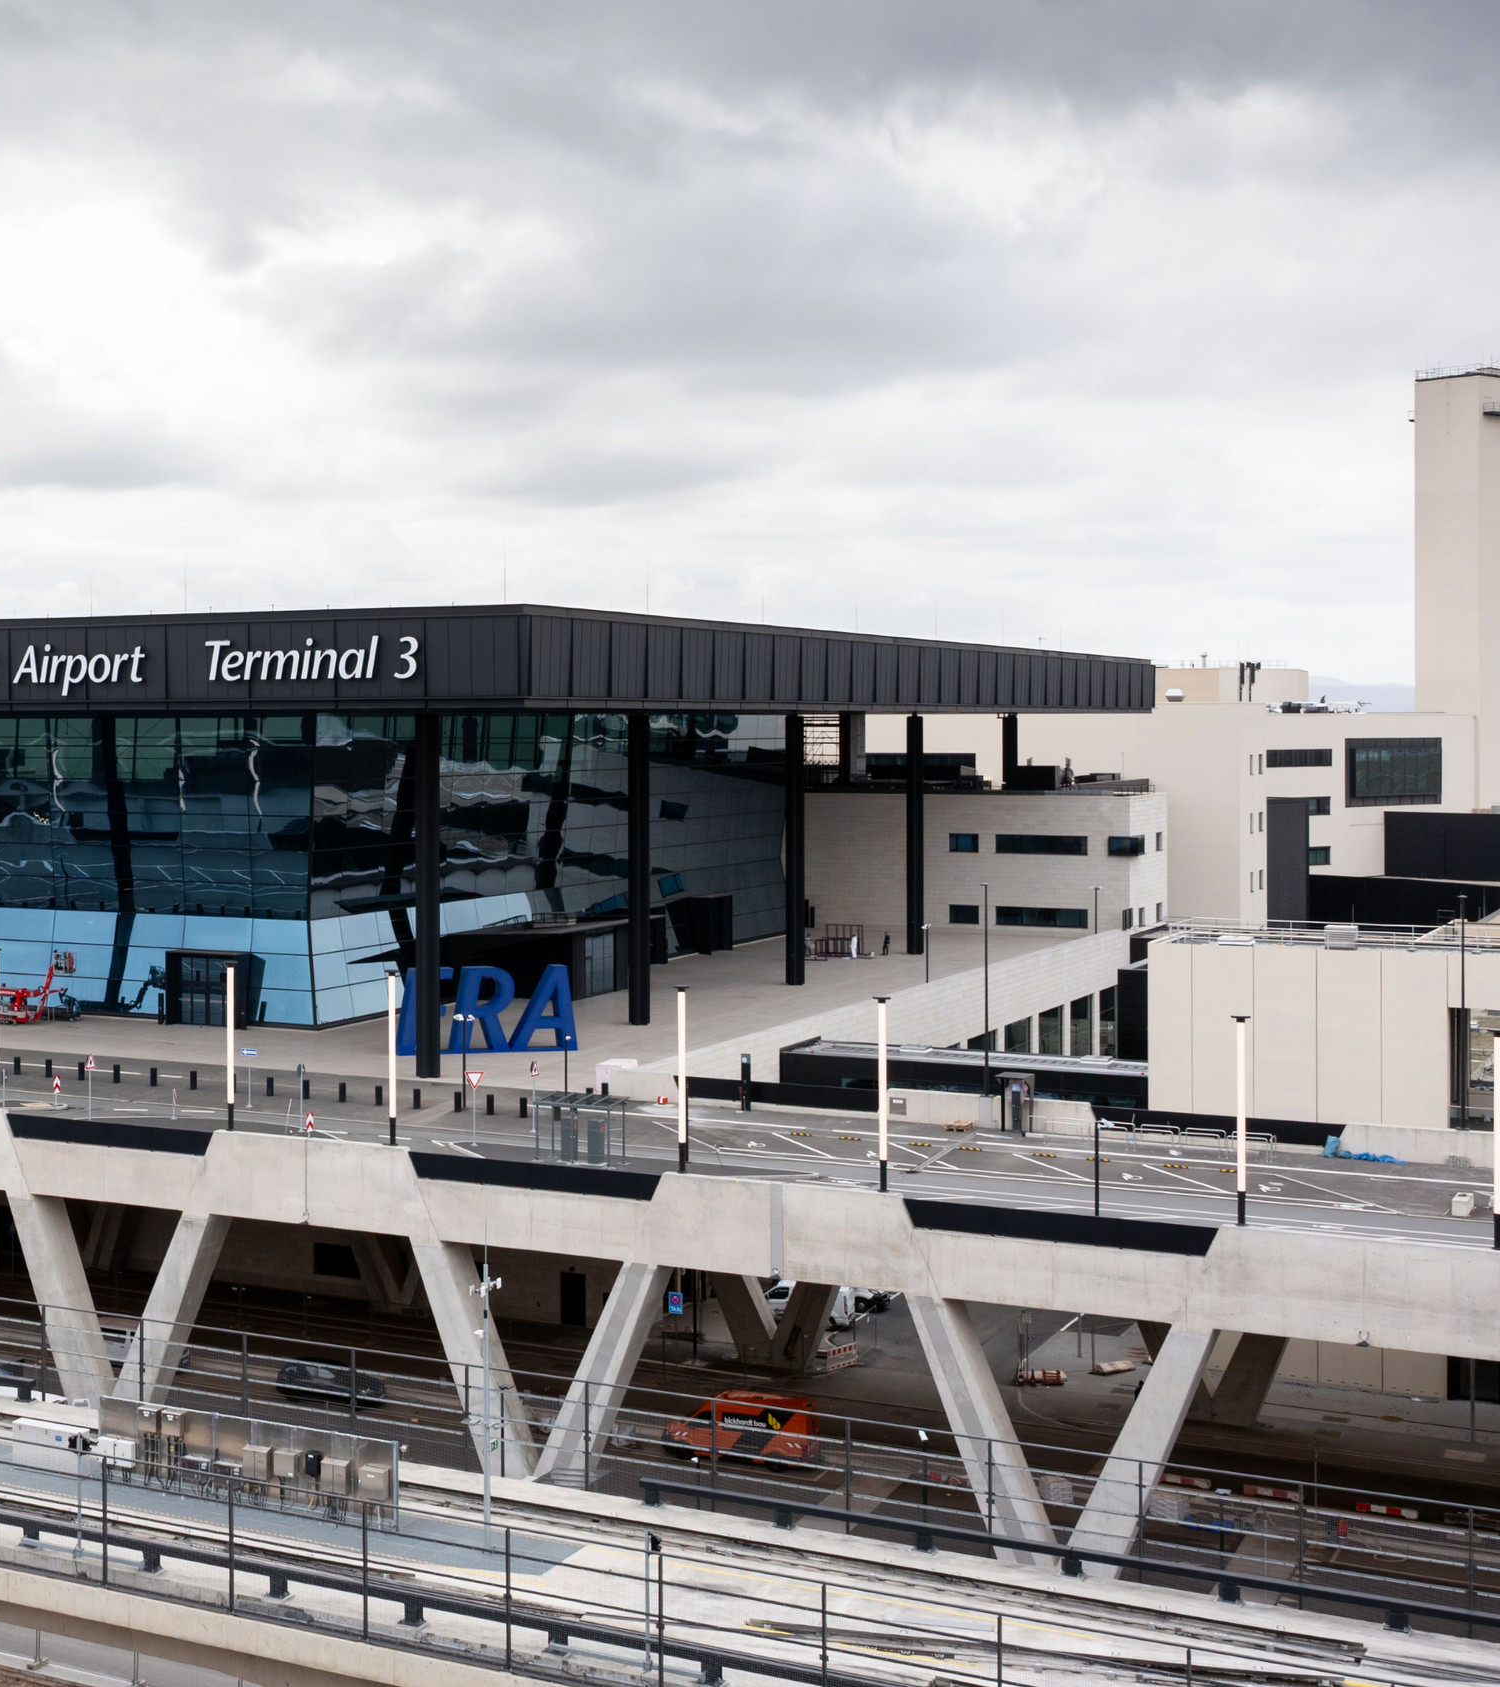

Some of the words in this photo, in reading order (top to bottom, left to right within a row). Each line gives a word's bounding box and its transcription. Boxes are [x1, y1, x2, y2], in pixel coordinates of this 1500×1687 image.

[12, 643, 146, 696] Airport
[204, 635, 379, 682] Terminal
[393, 636, 419, 679] 3
[396, 964, 578, 1056] FRA
[754, 1419, 767, 1428] bau
